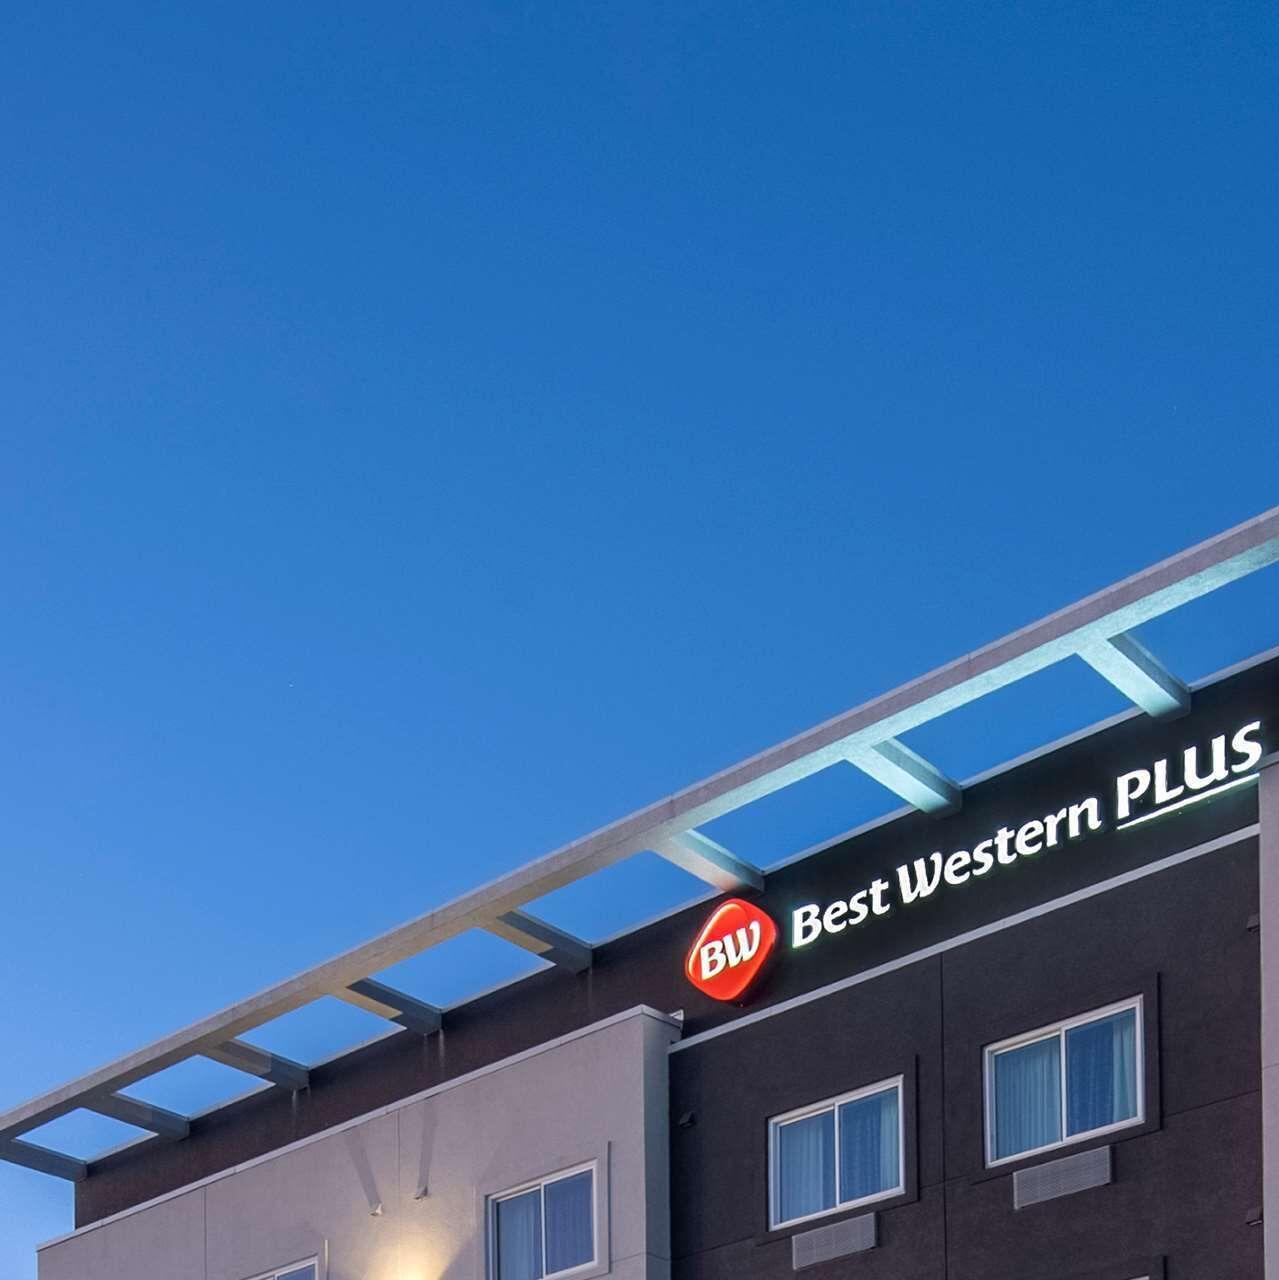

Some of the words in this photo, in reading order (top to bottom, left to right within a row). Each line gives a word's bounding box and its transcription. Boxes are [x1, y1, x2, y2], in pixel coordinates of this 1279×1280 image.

[791, 878, 891, 949] Best
[896, 795, 1103, 905] Western
[1116, 719, 1264, 821] PLUS
[699, 918, 762, 980] BW
